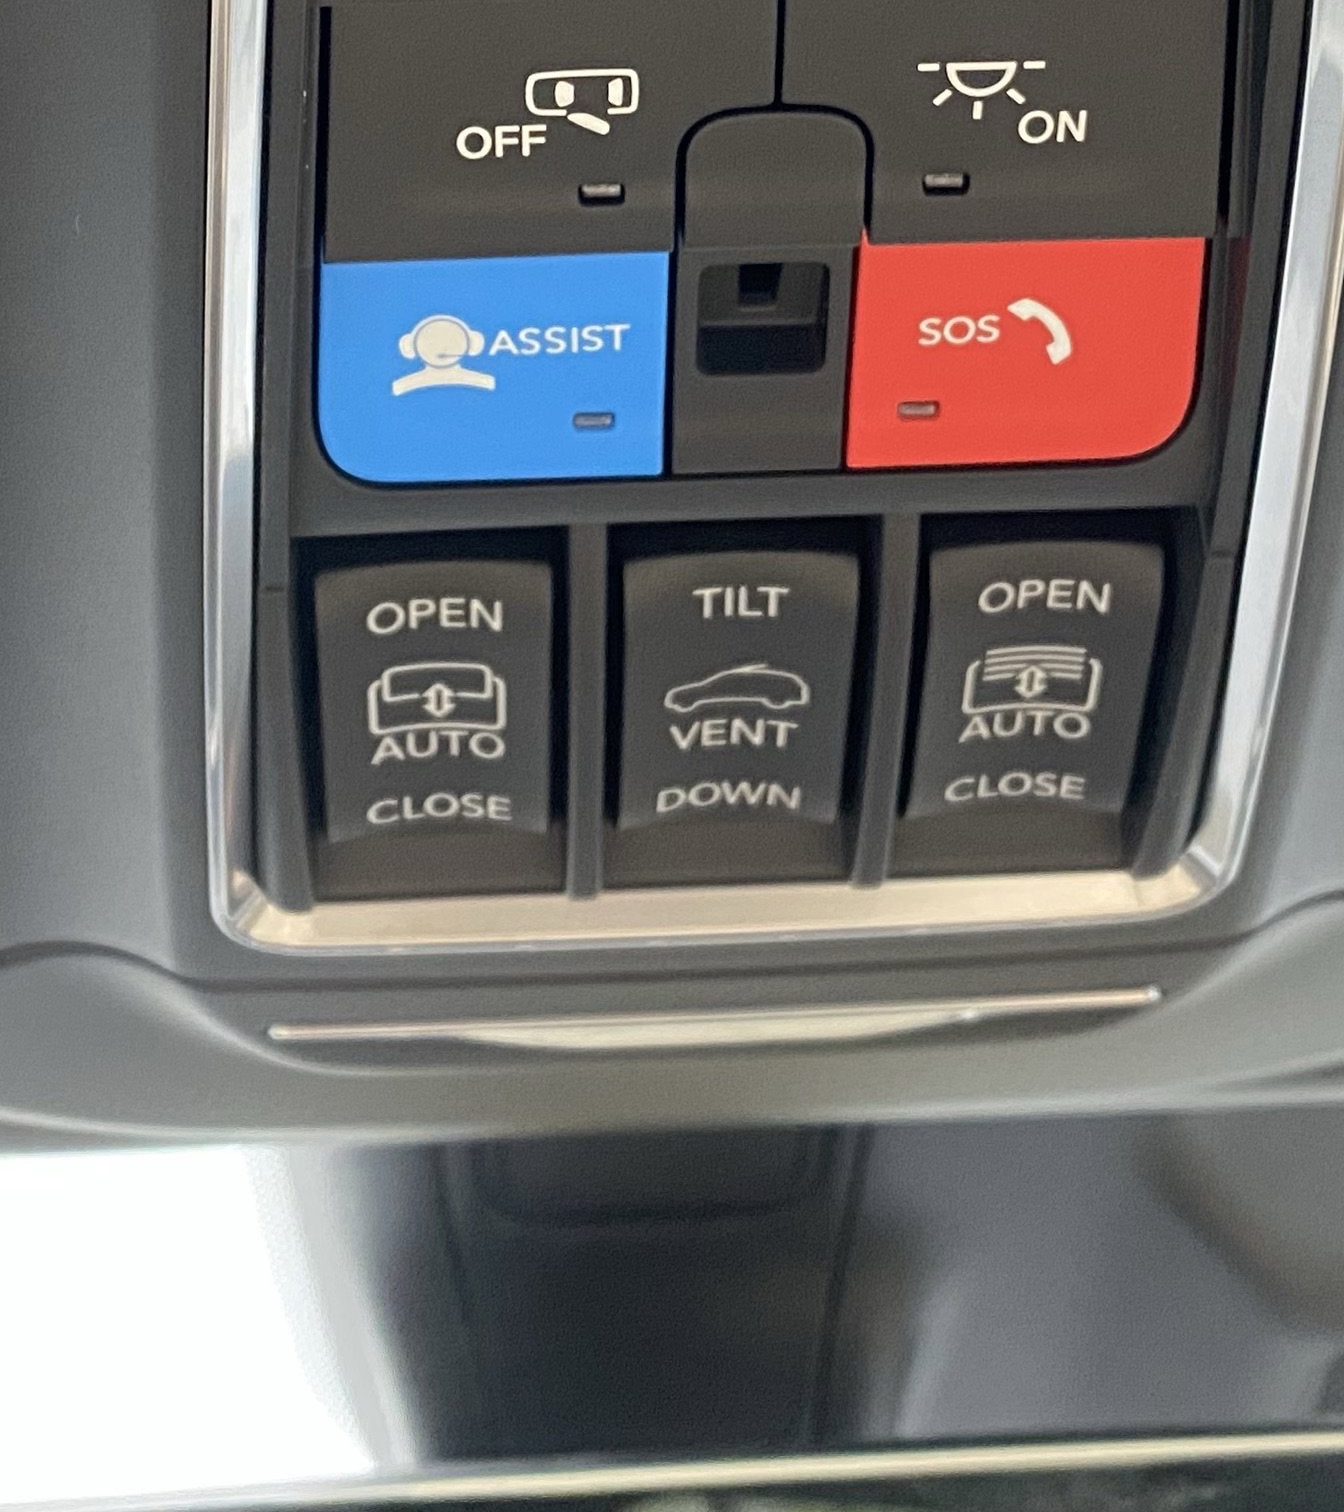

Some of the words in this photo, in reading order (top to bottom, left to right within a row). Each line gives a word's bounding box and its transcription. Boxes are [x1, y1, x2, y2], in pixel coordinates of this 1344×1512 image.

[456, 124, 547, 160] OFF
[1018, 110, 1088, 145] ON
[490, 324, 631, 356] ASSIST
[919, 315, 1000, 346] SOS
[693, 586, 789, 619] TILT
[978, 580, 1111, 614] OPEN
[367, 597, 503, 636] OPEN
[669, 718, 798, 750] VENT
[959, 711, 1091, 742] AUTO
[371, 731, 506, 764] AUTO
[656, 781, 801, 814] DOWN
[945, 771, 1085, 803] CLOSE
[367, 794, 513, 826] CLOSE
